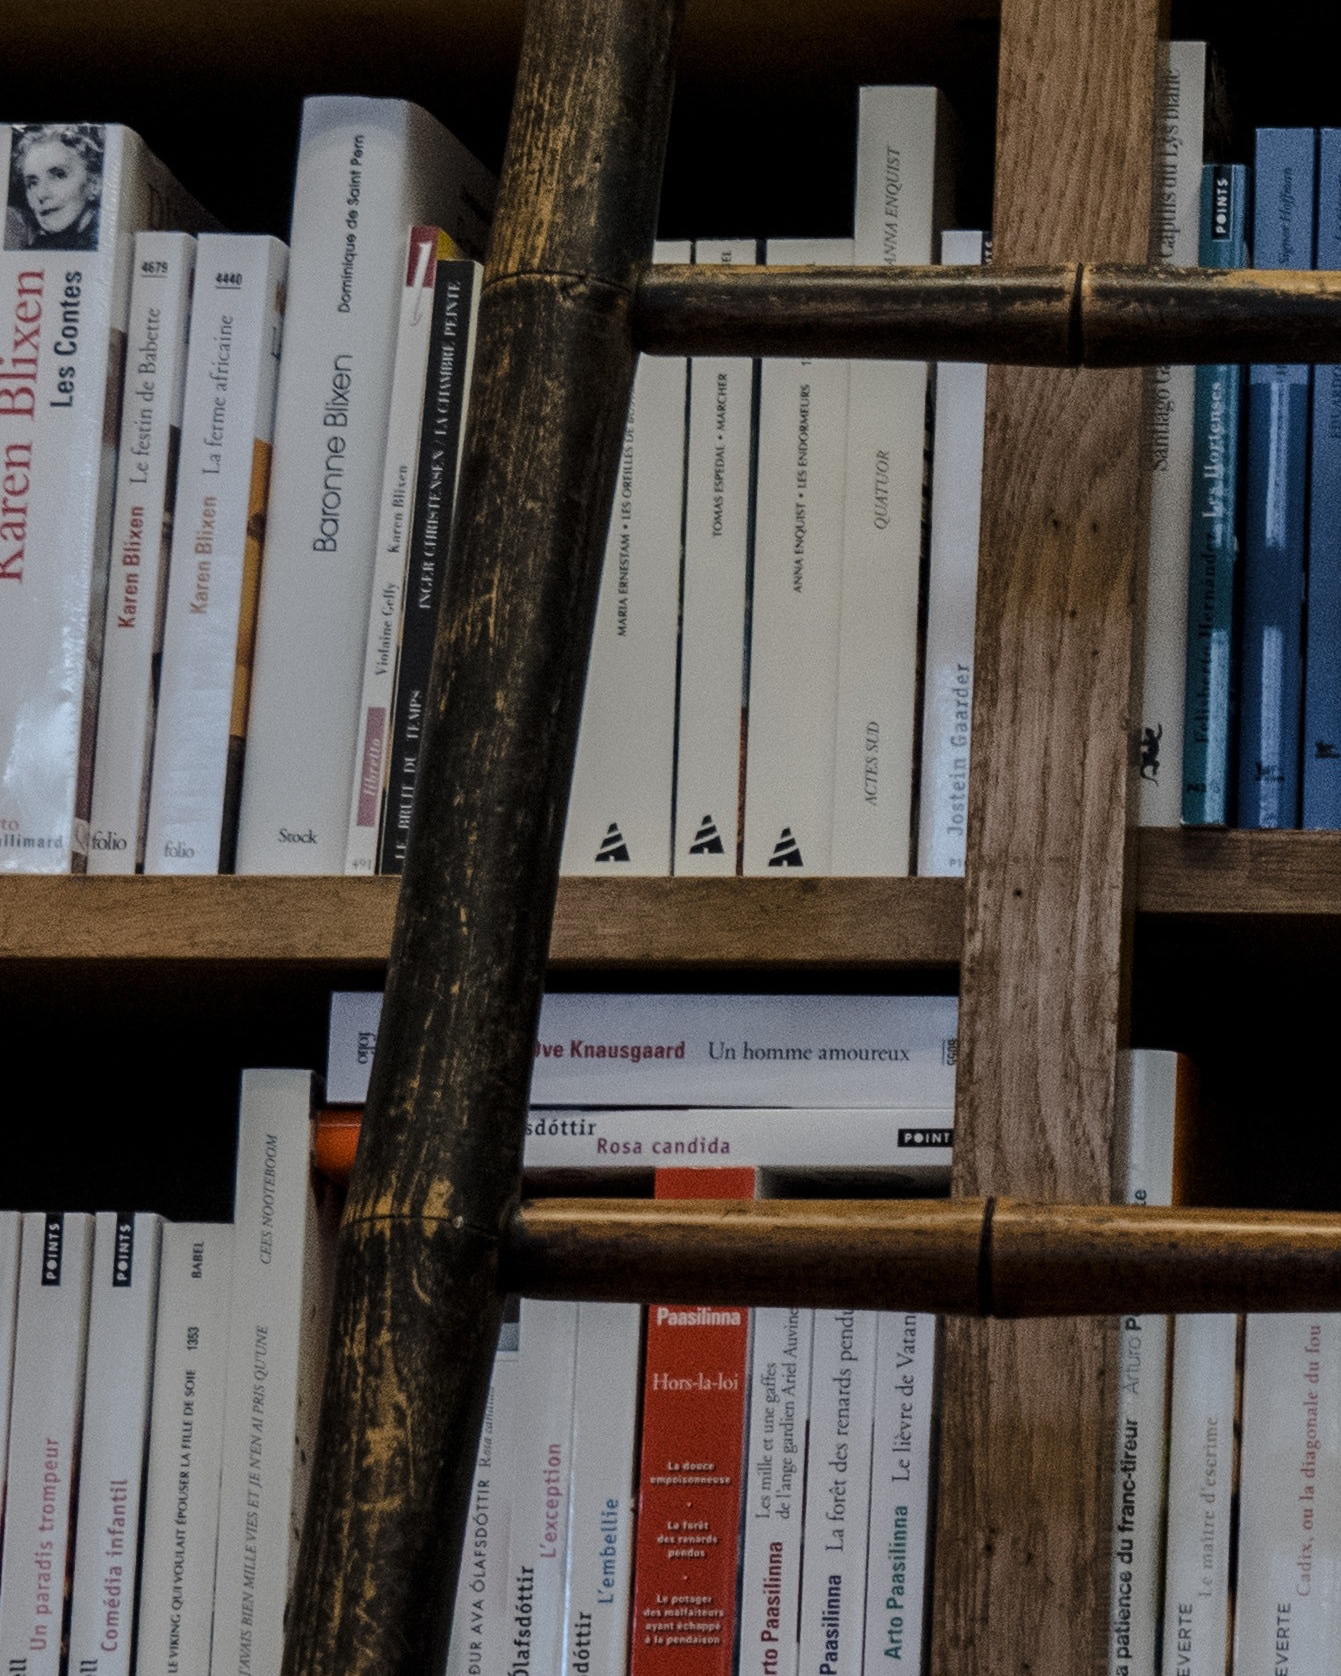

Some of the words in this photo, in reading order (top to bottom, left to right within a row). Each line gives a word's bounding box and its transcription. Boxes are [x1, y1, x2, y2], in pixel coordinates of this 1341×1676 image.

[0, 271, 44, 417] Blixen
[53, 271, 82, 356] Contes
[50, 366, 75, 407] Les
[323, 354, 352, 427] Blixen
[0, 444, 32, 581] Karen
[312, 436, 346, 552] Baronne
[874, 450, 890, 530] QUATUOR
[570, 1040, 685, 1063] Knausgaard
[709, 1041, 736, 1060] Un
[743, 1041, 812, 1060] homme
[818, 1048, 909, 1061] amoureux
[652, 1372, 738, 1390] Hors-la-loi
[895, 1375, 914, 1397] de
[892, 1403, 913, 1452] lièvre
[38, 1438, 61, 1532] trompeur
[891, 1459, 910, 1481] Le
[34, 1541, 53, 1615] paradis
[886, 1506, 908, 1610] Paasilinna
[29, 1625, 47, 1651] Un
[884, 1616, 903, 1660] Arto
